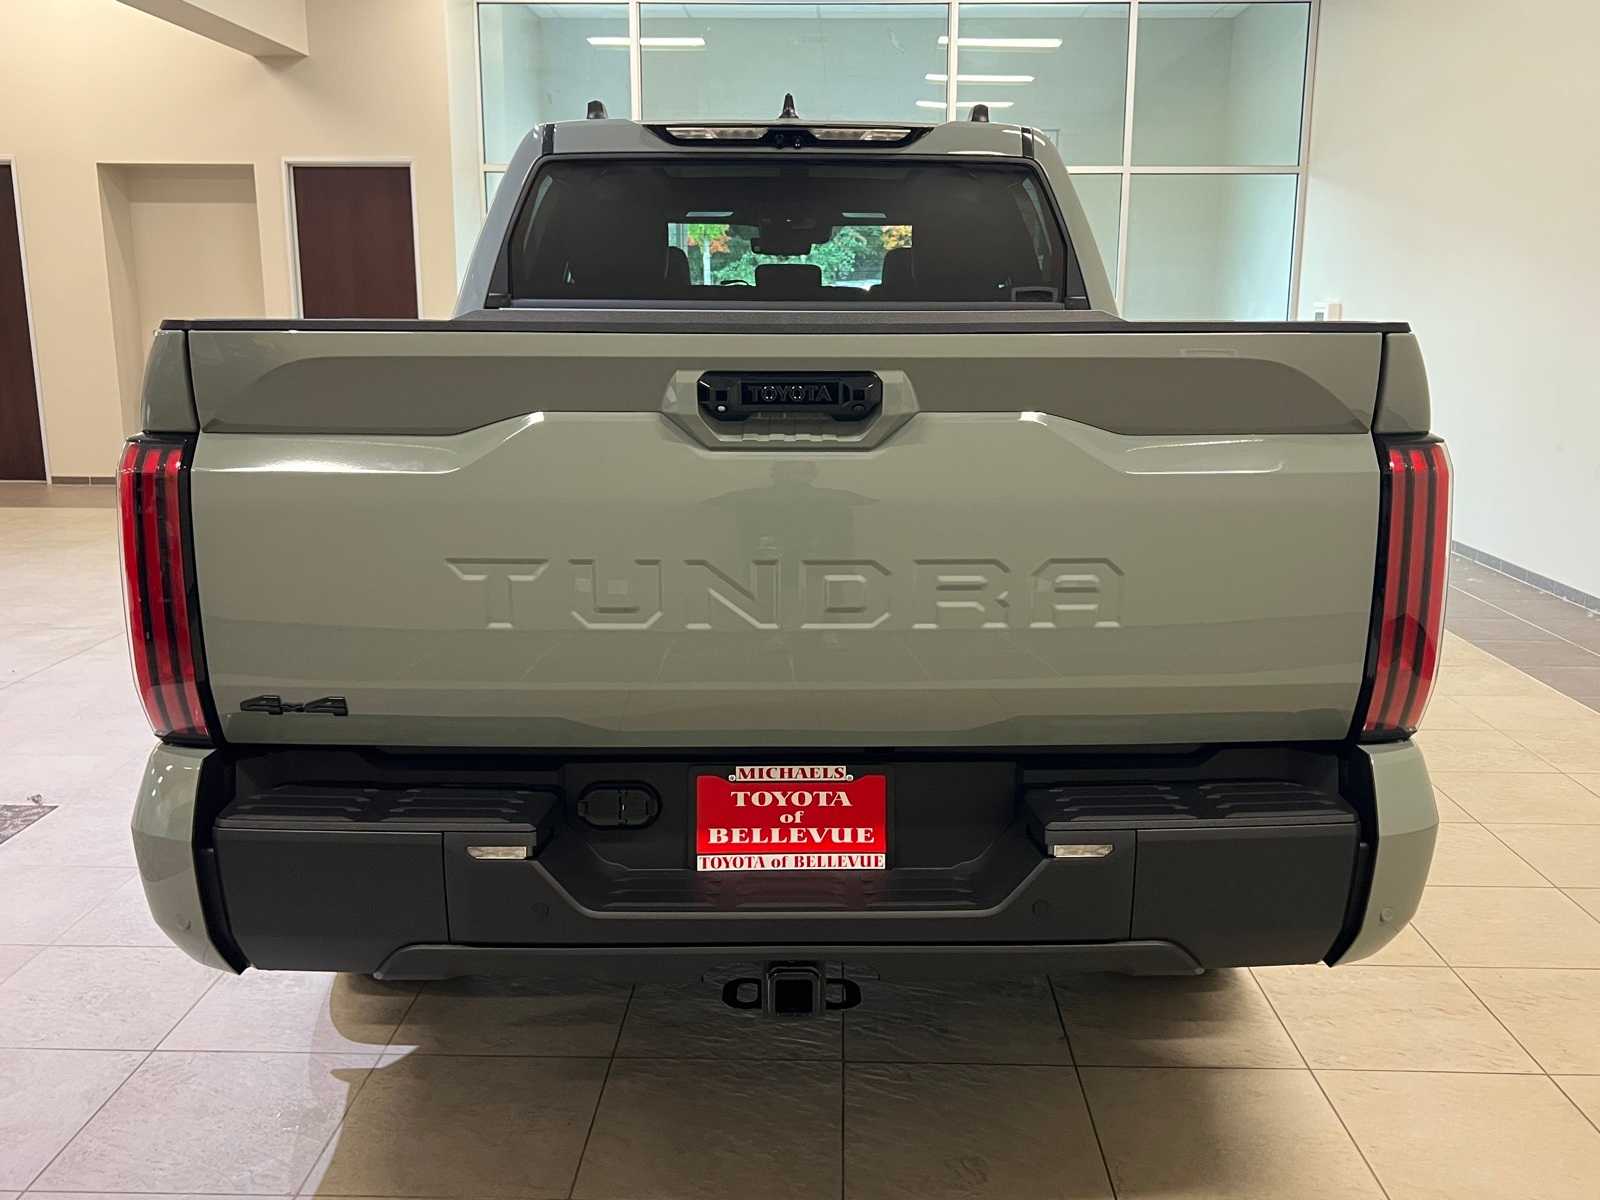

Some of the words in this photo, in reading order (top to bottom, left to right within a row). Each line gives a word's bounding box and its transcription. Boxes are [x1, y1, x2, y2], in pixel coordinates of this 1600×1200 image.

[748, 384, 833, 401] TOYOTA
[444, 557, 1125, 630] TUNDRA
[738, 766, 846, 780] MICHAELS
[730, 790, 853, 807] TOYOTA
[779, 810, 805, 824] of
[708, 827, 875, 844] BELLEVUE
[699, 856, 766, 870] TOYOTA
[771, 855, 789, 869] of
[794, 855, 885, 869] BELLEVUE
